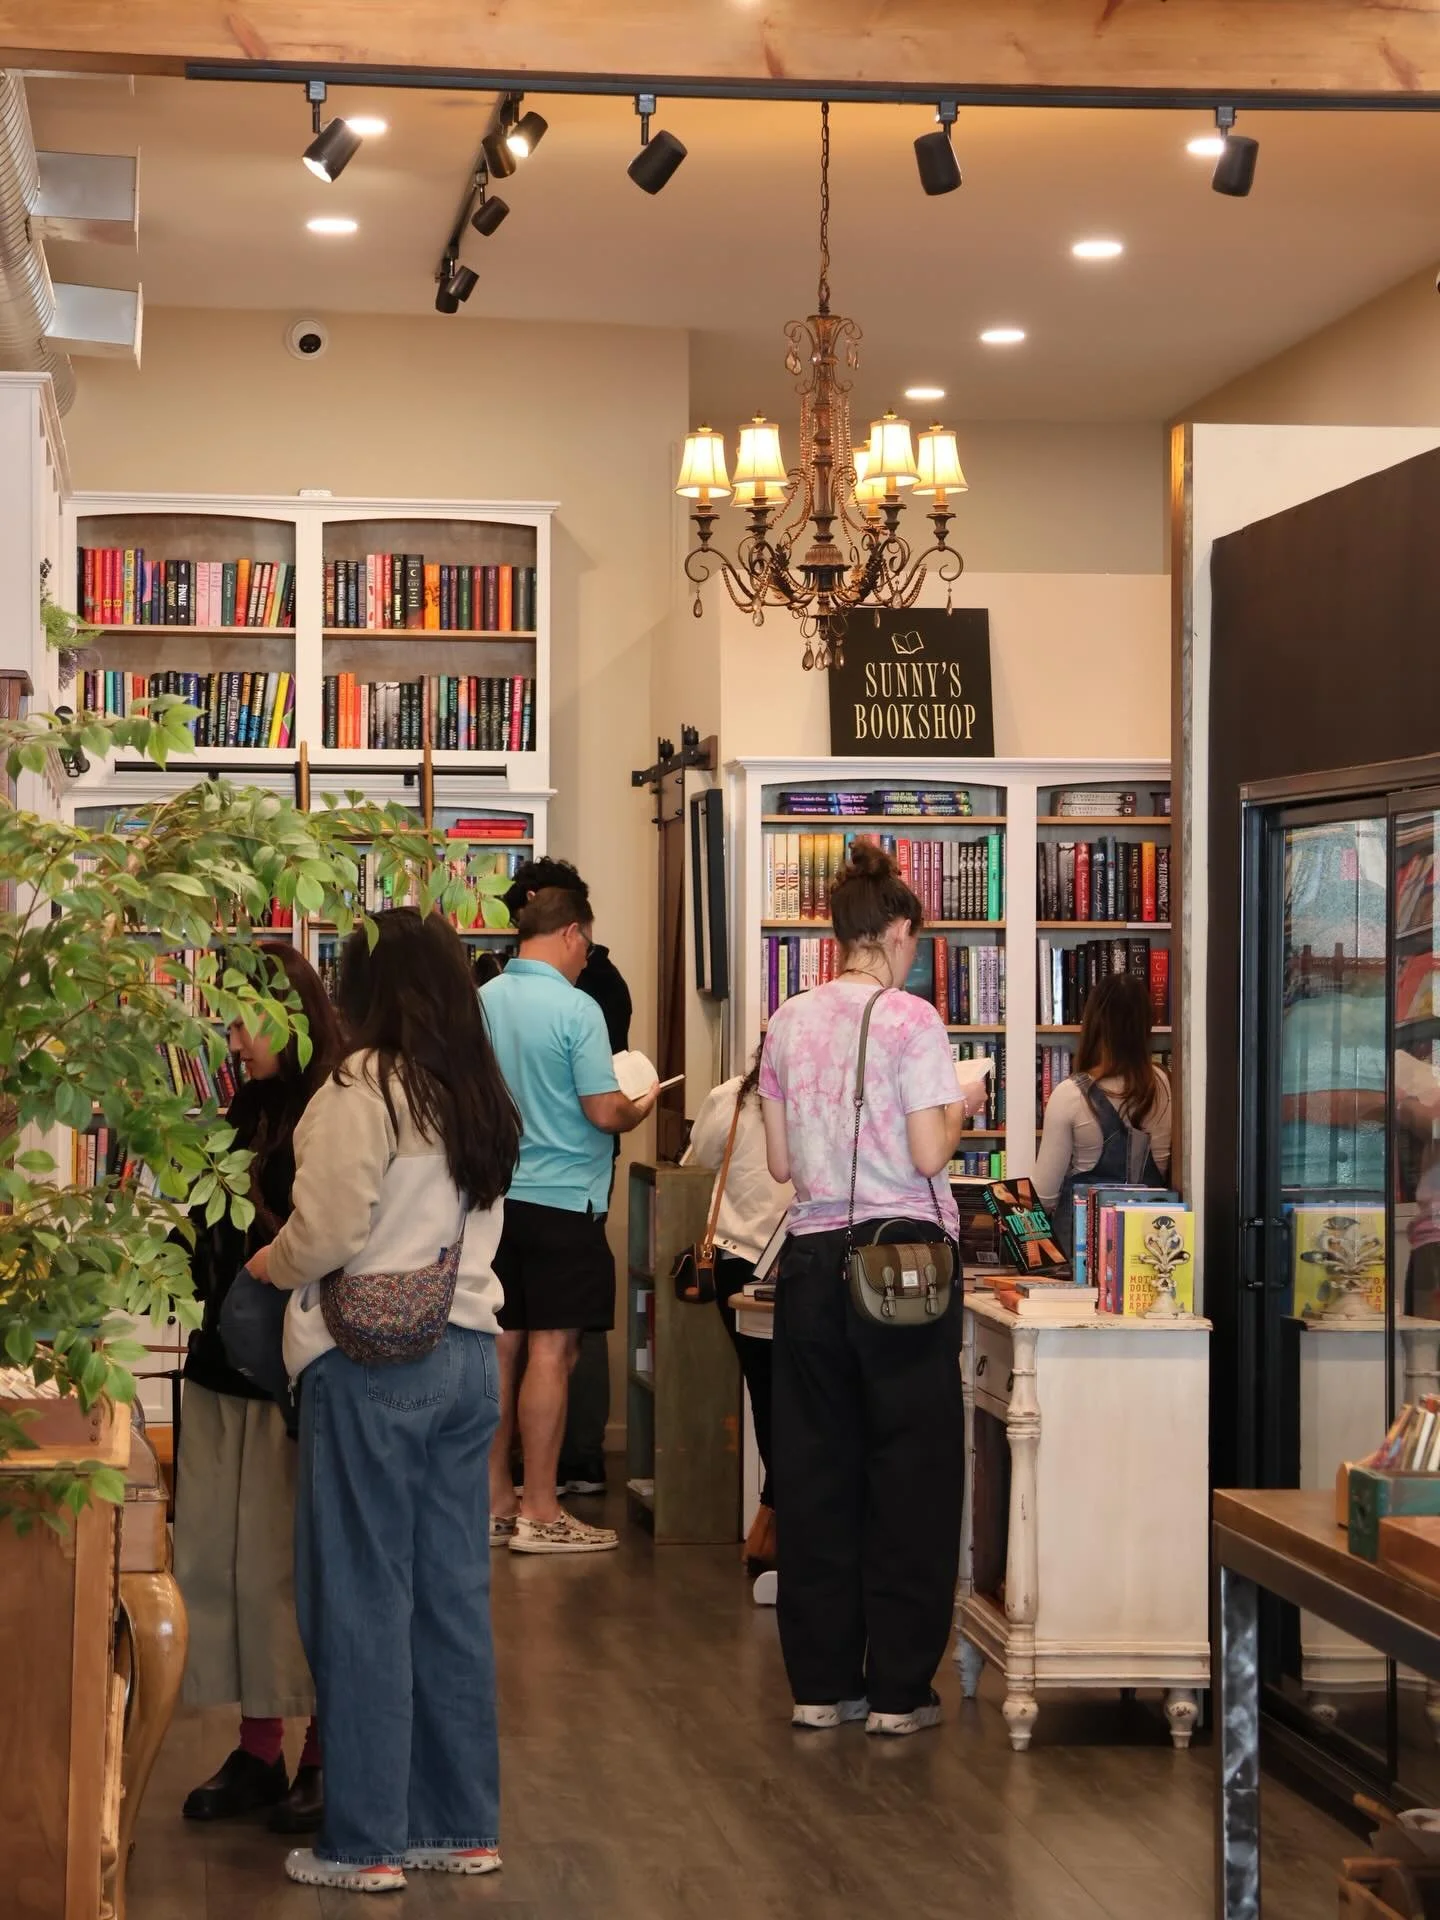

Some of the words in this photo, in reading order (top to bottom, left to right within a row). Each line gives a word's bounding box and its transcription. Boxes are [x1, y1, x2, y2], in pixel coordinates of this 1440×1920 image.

[178, 584, 188, 606] FINALE
[230, 674, 239, 701] LOUISE
[865, 662, 962, 698] SUNNY'S
[513, 680, 521, 712] SALTWATER
[854, 703, 976, 740] BOOKSHOP
[775, 862, 786, 891] CRUX
[788, 862, 799, 891] CRUX
